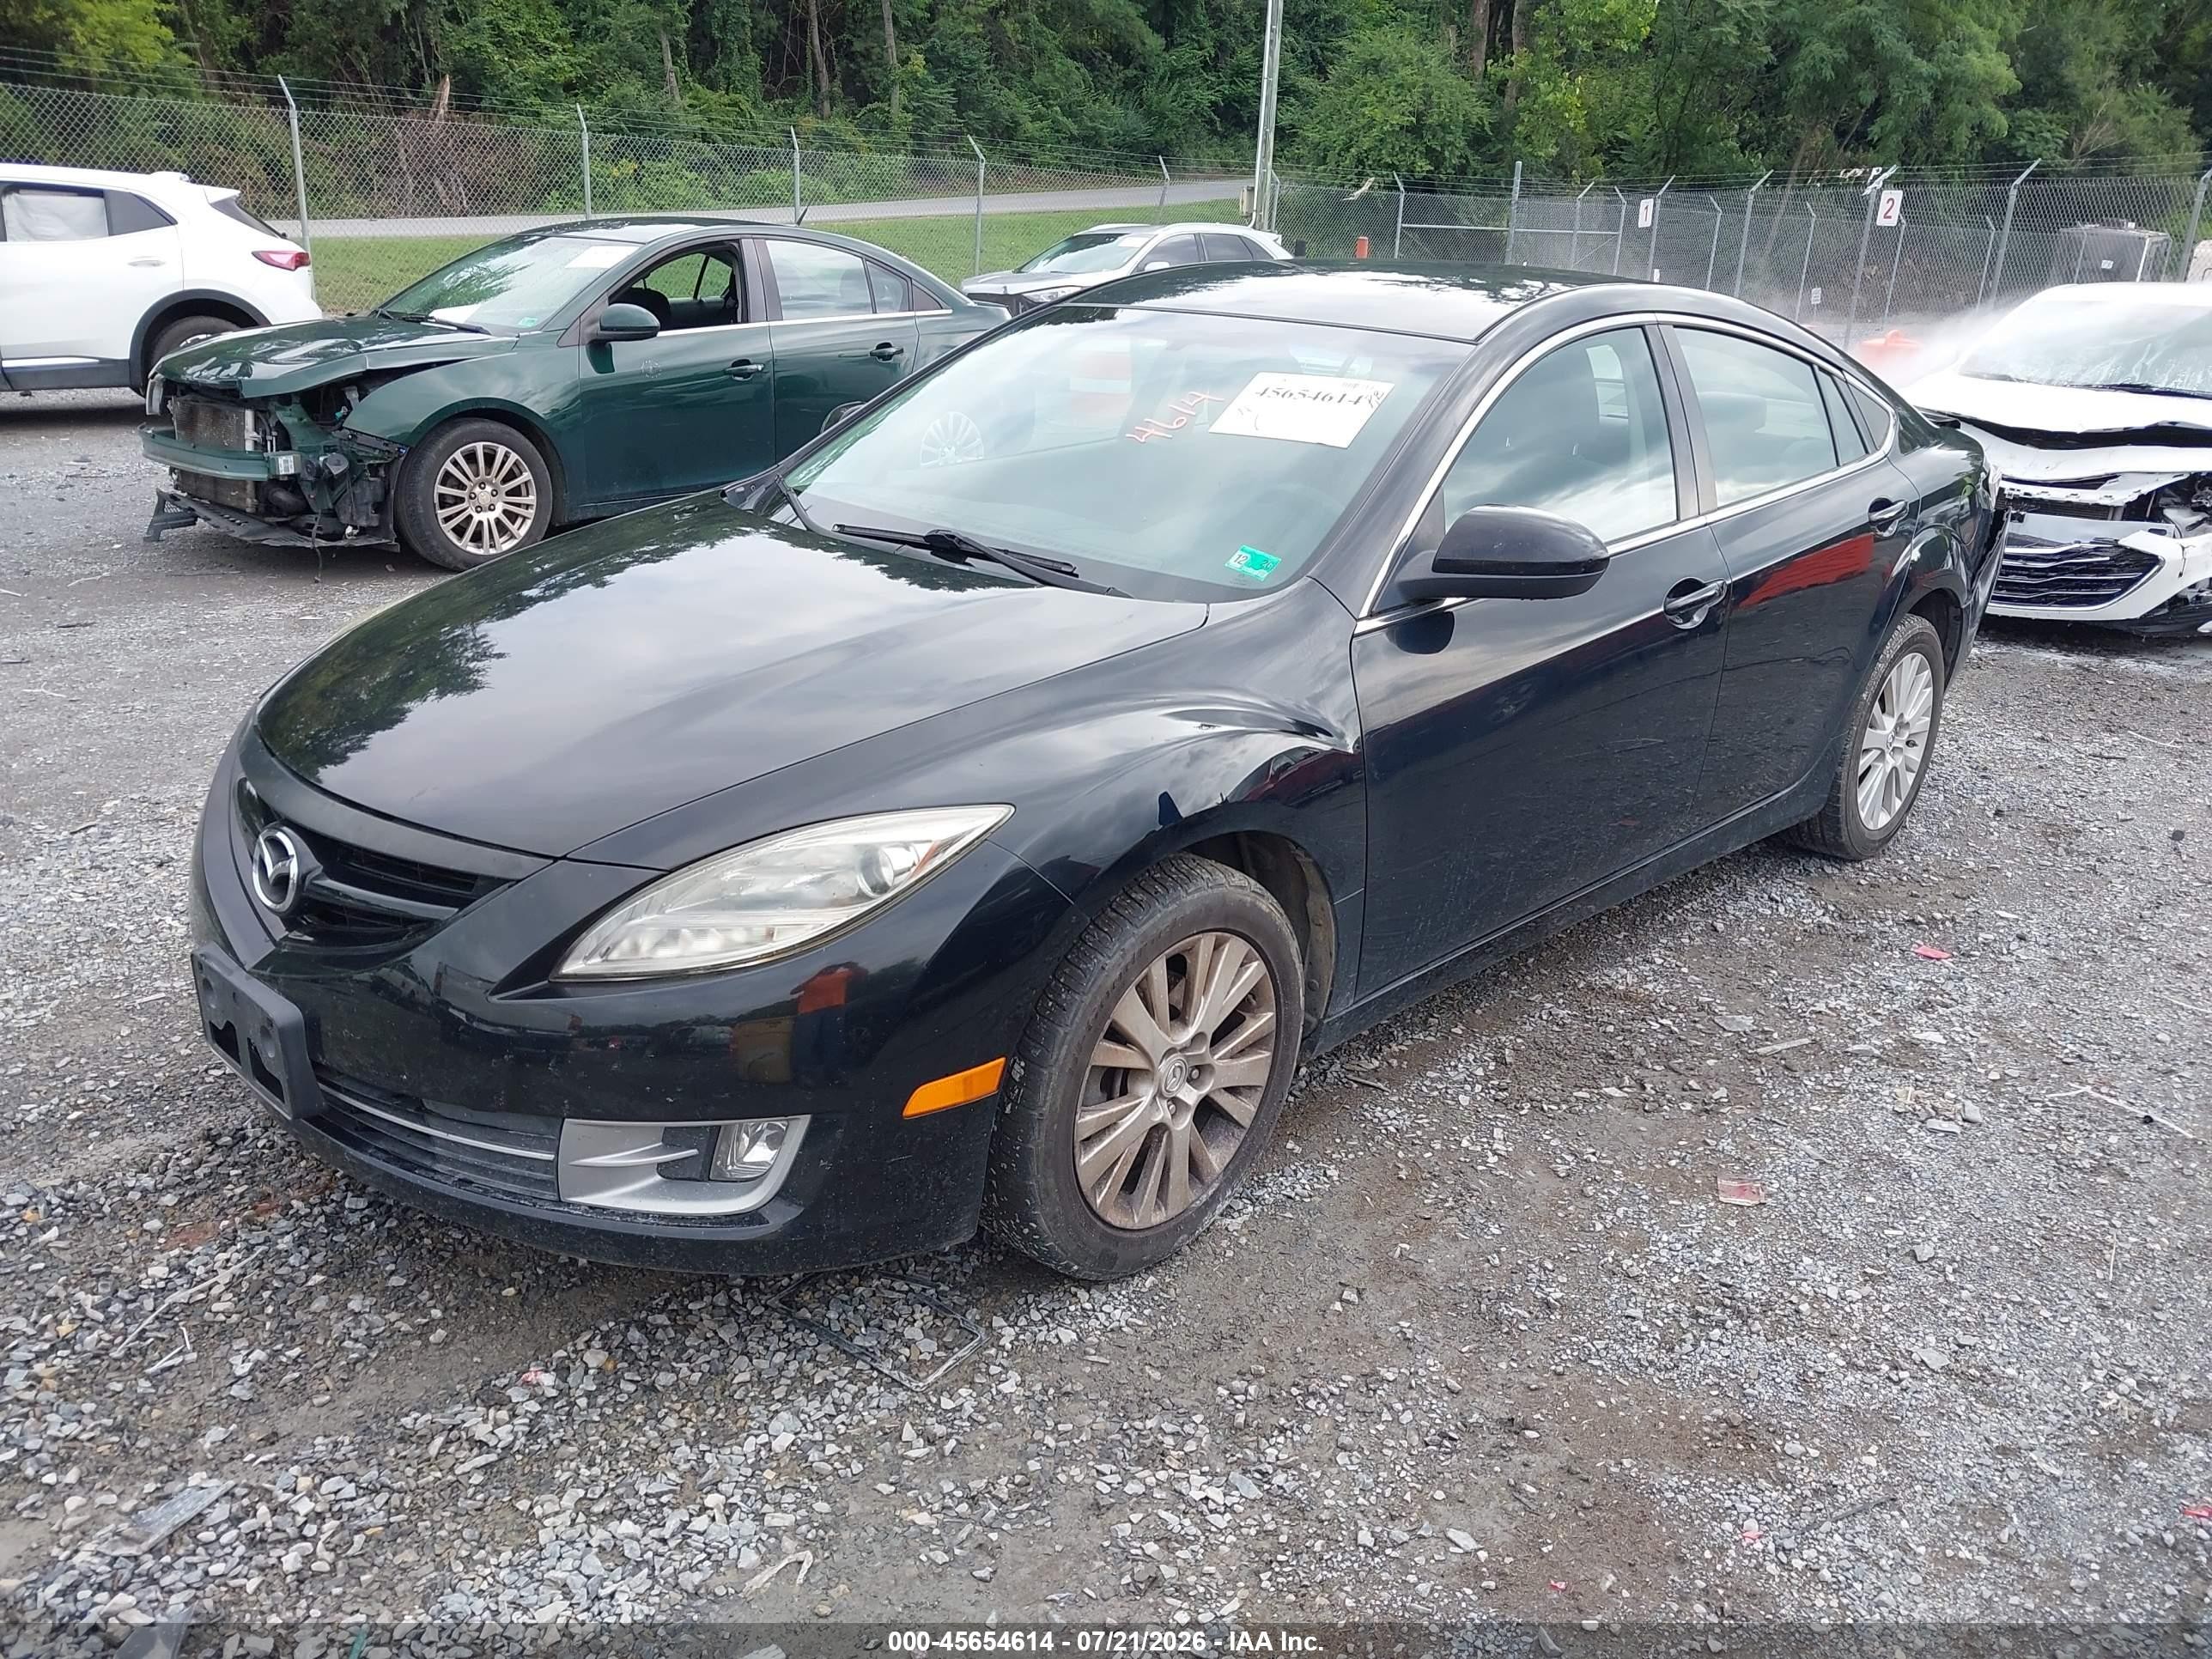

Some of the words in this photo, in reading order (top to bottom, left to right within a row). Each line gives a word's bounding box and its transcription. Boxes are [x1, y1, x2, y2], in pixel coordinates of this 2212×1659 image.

[1644, 204, 1650, 222] 1
[1883, 198, 1895, 219] 2
[1125, 391, 1224, 443] 4614
[1233, 554, 1249, 565] 12
